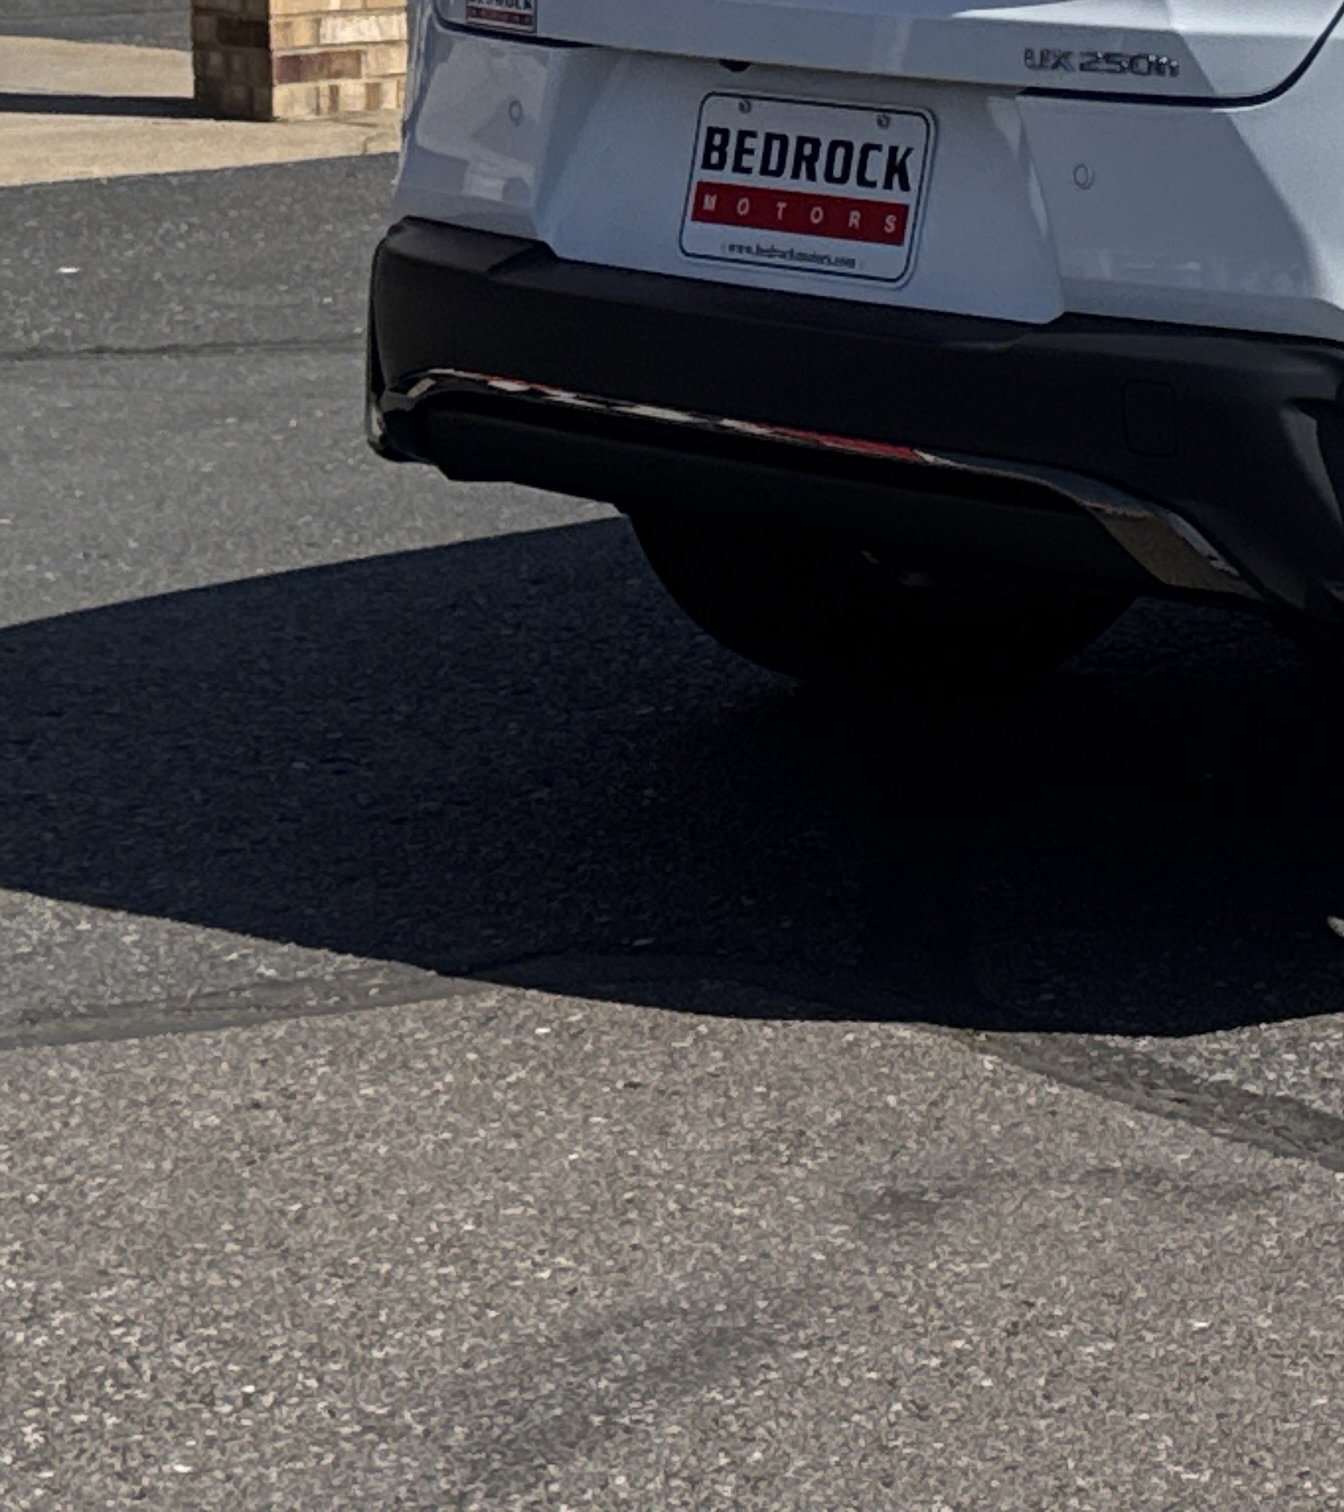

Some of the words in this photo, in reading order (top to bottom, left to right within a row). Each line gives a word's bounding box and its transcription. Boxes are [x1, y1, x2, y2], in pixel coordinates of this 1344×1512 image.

[1024, 48, 1075, 72] UX
[701, 126, 914, 192] BEDROCK
[702, 193, 898, 234] MOTORS
